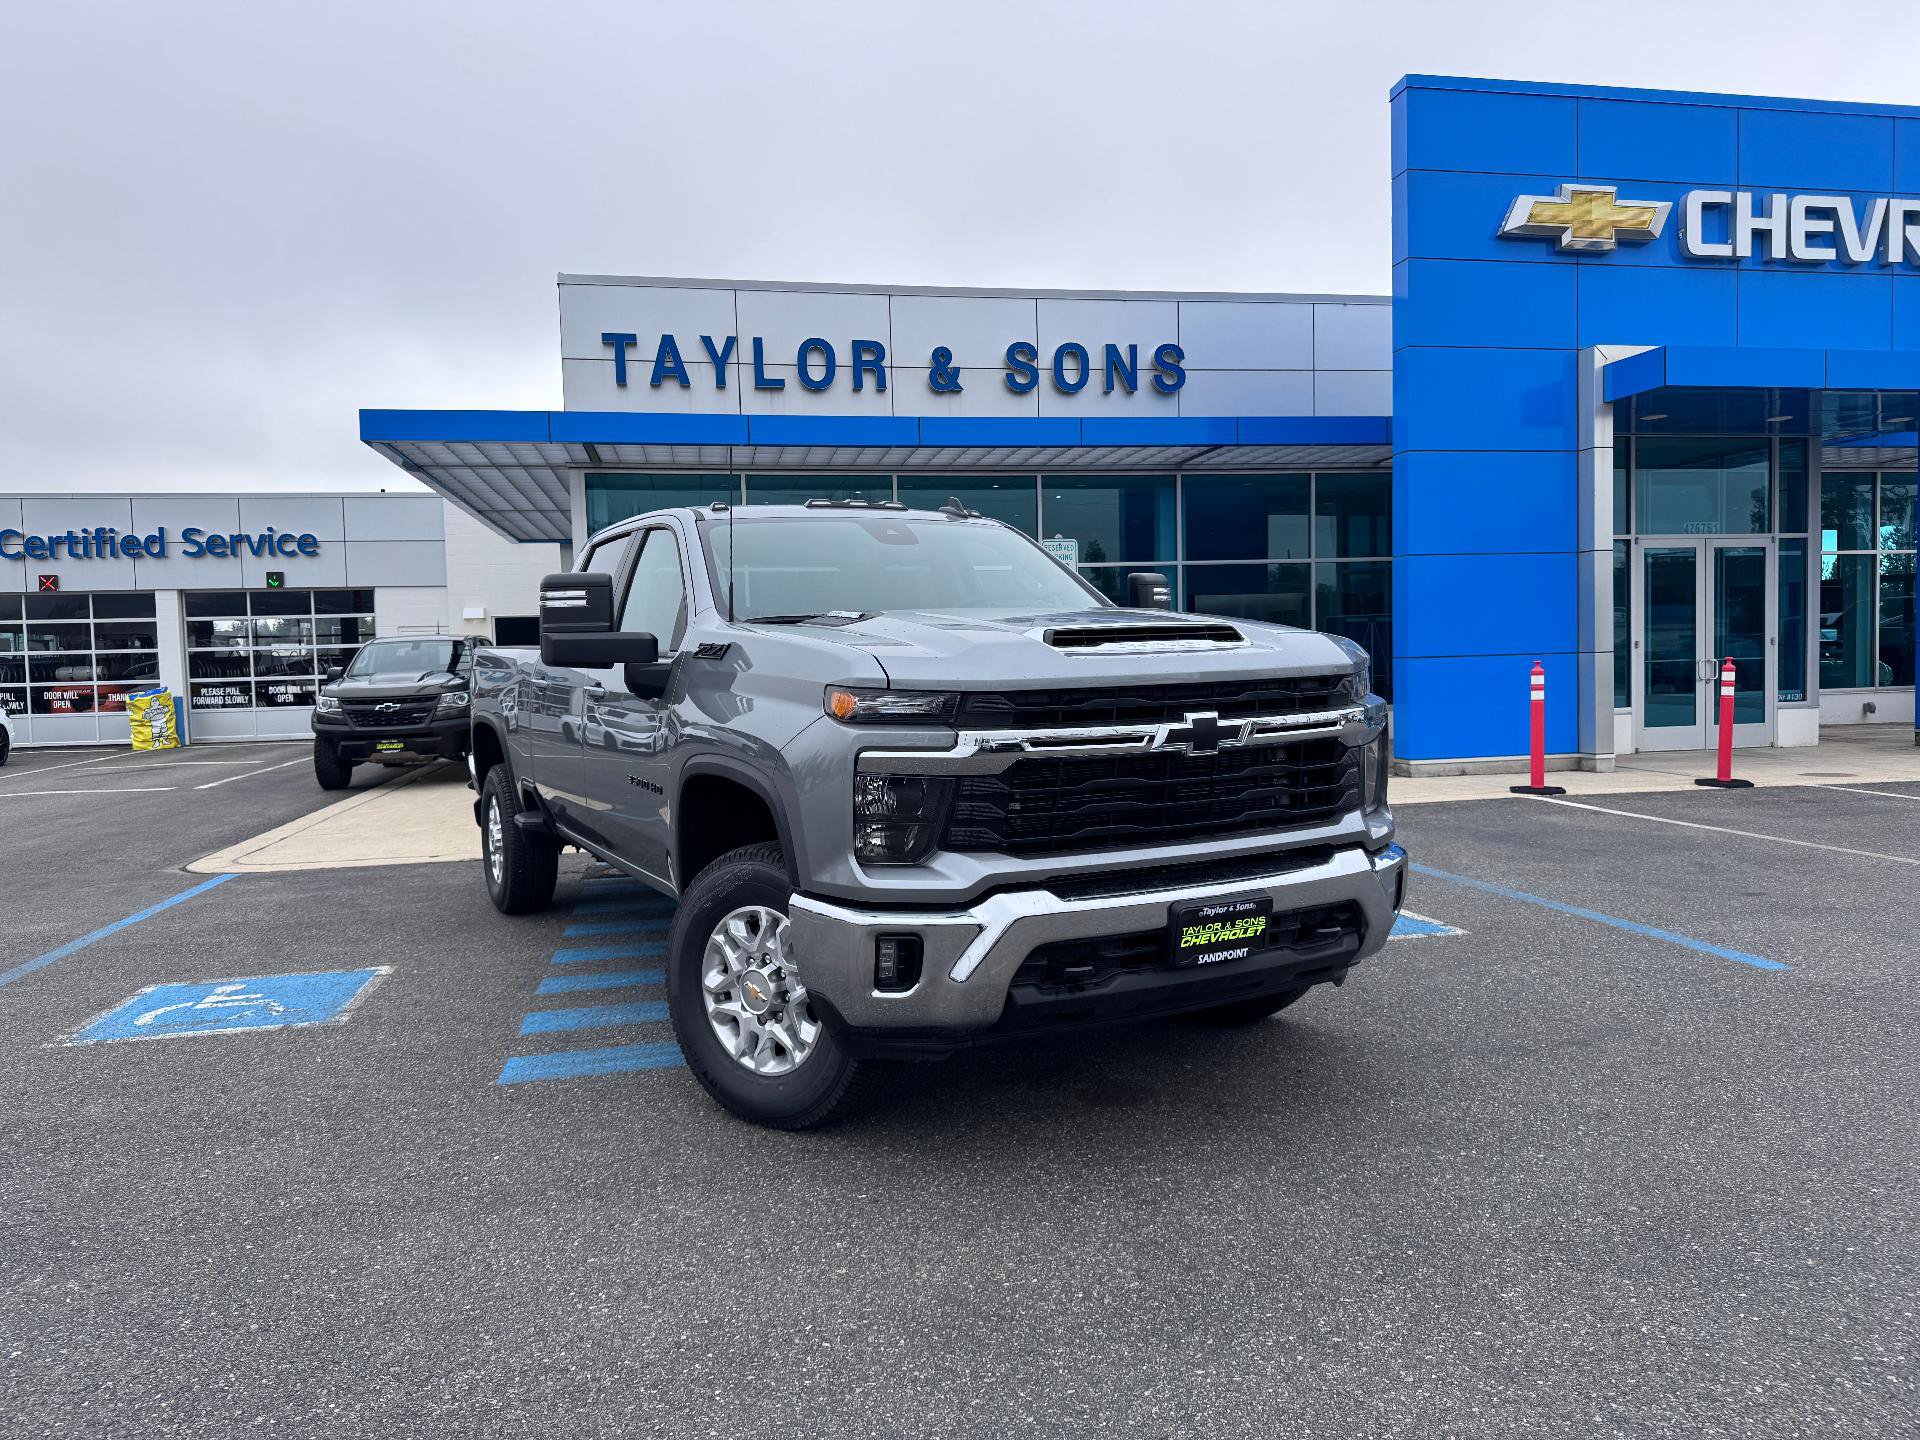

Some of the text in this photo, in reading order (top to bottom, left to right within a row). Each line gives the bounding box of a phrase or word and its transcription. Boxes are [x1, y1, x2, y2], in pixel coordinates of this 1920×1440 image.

[601, 332, 1187, 394] TAYLOR & SONS
[0, 526, 320, 560] Certified Service
[43, 691, 62, 700] DOOR
[63, 690, 79, 700] WILL
[201, 687, 241, 697] PLEASE PULL
[268, 685, 286, 694] DOOR
[287, 684, 302, 694] WILL
[53, 700, 71, 709] OPEN
[193, 695, 249, 705] FORWARD SLOWLY
[277, 694, 294, 703] OPEN
[1202, 906, 1228, 917] Taylor
[1235, 902, 1254, 912] Sons
[1182, 916, 1266, 937] TAYLOR & SONS
[1180, 926, 1266, 948] CHEVROLET
[1197, 948, 1249, 965] SANDPOINT
